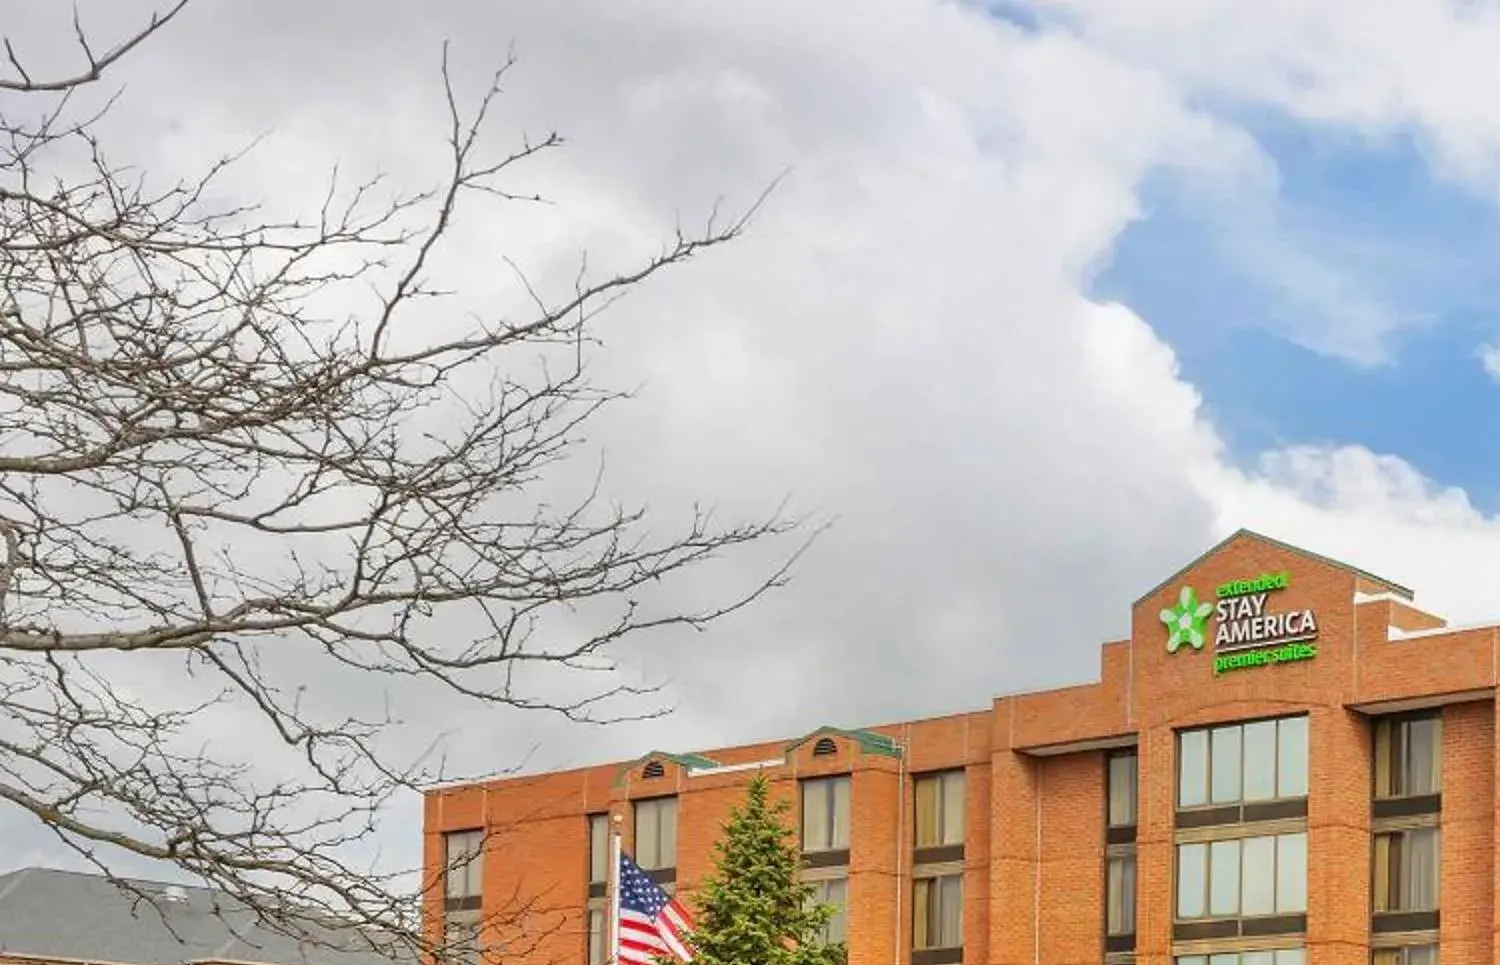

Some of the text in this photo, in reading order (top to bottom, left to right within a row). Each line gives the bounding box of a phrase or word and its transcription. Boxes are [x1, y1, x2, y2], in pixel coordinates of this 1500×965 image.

[1216, 573, 1288, 597] extended
[1216, 594, 1267, 622] STAY
[1215, 610, 1316, 645] AMERICA
